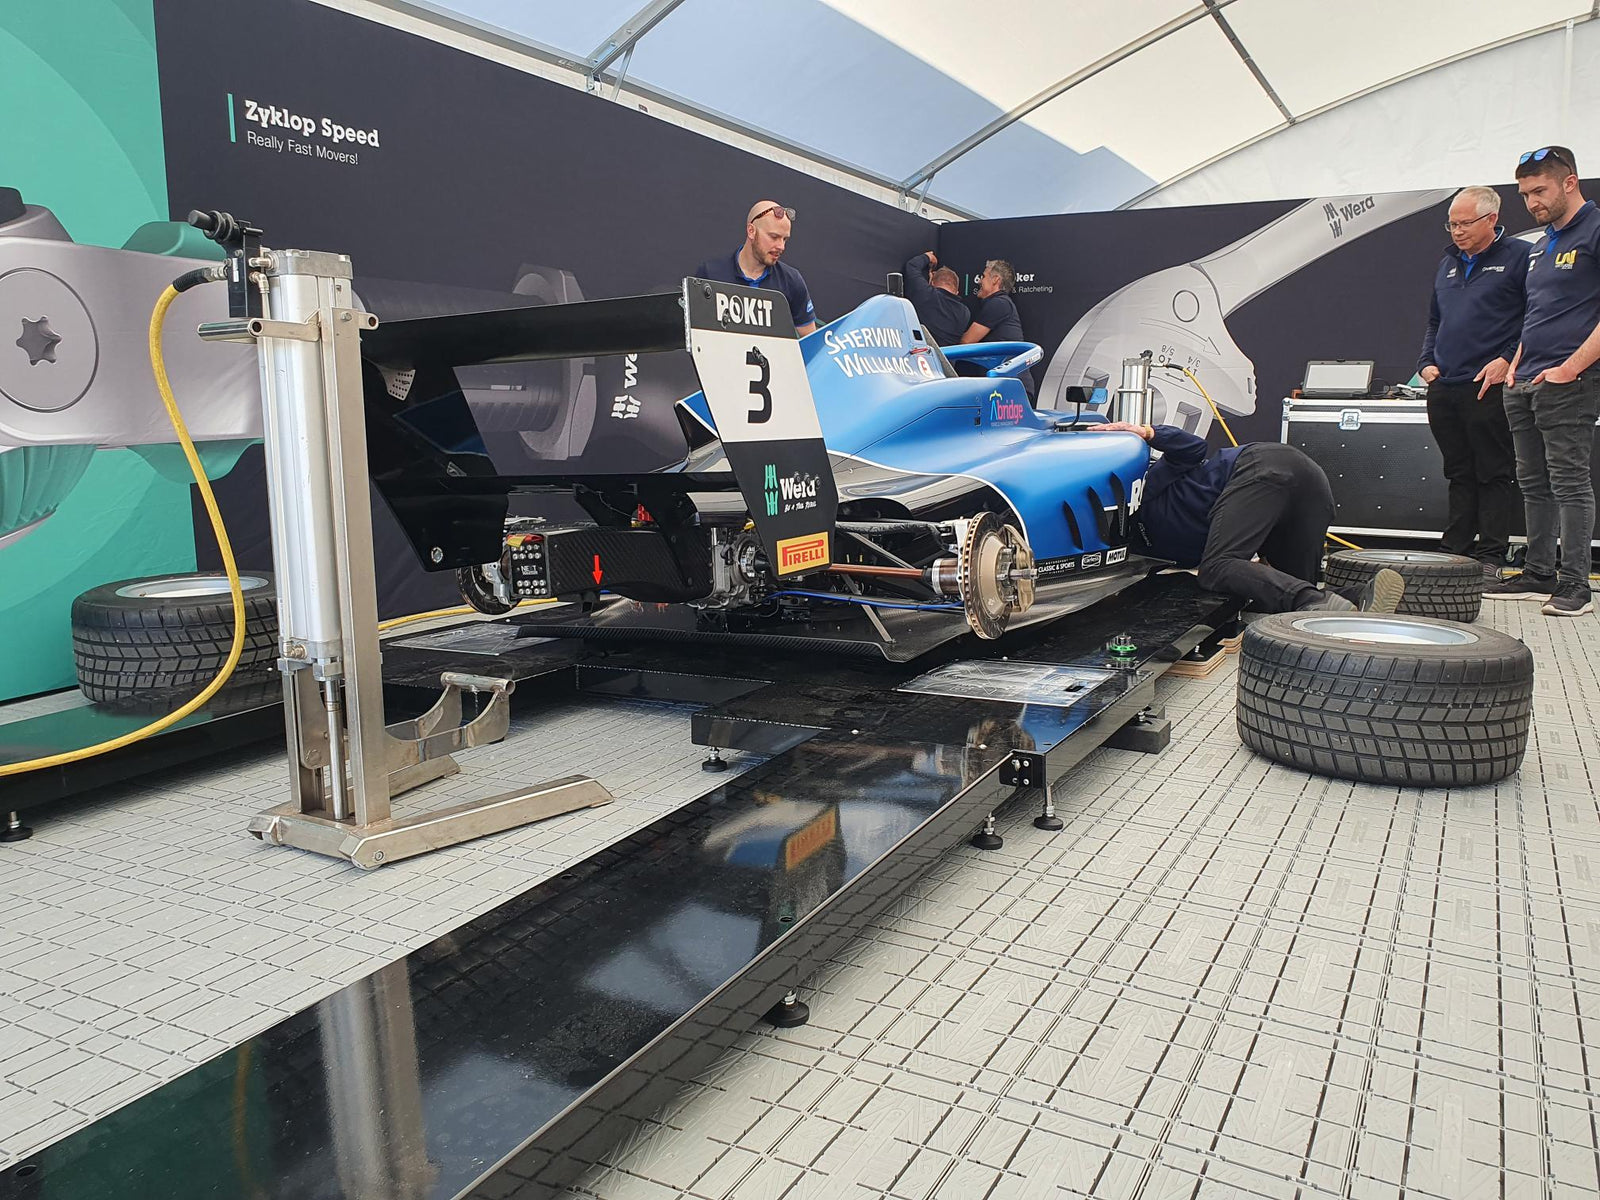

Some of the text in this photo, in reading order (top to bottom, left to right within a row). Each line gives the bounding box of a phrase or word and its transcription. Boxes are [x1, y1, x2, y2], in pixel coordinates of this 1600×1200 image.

[244, 99, 380, 148] Zyklop Speed
[247, 130, 359, 165] Really Fast Movers!
[1339, 195, 1375, 222] Wera
[1018, 285, 1053, 293] Ratcheting
[824, 327, 903, 355] SHERWIN
[745, 350, 773, 424] 3
[782, 540, 825, 567] PIRELLI
[1038, 564, 1056, 573] CLASSIC
[1060, 561, 1075, 569] SPORTS
